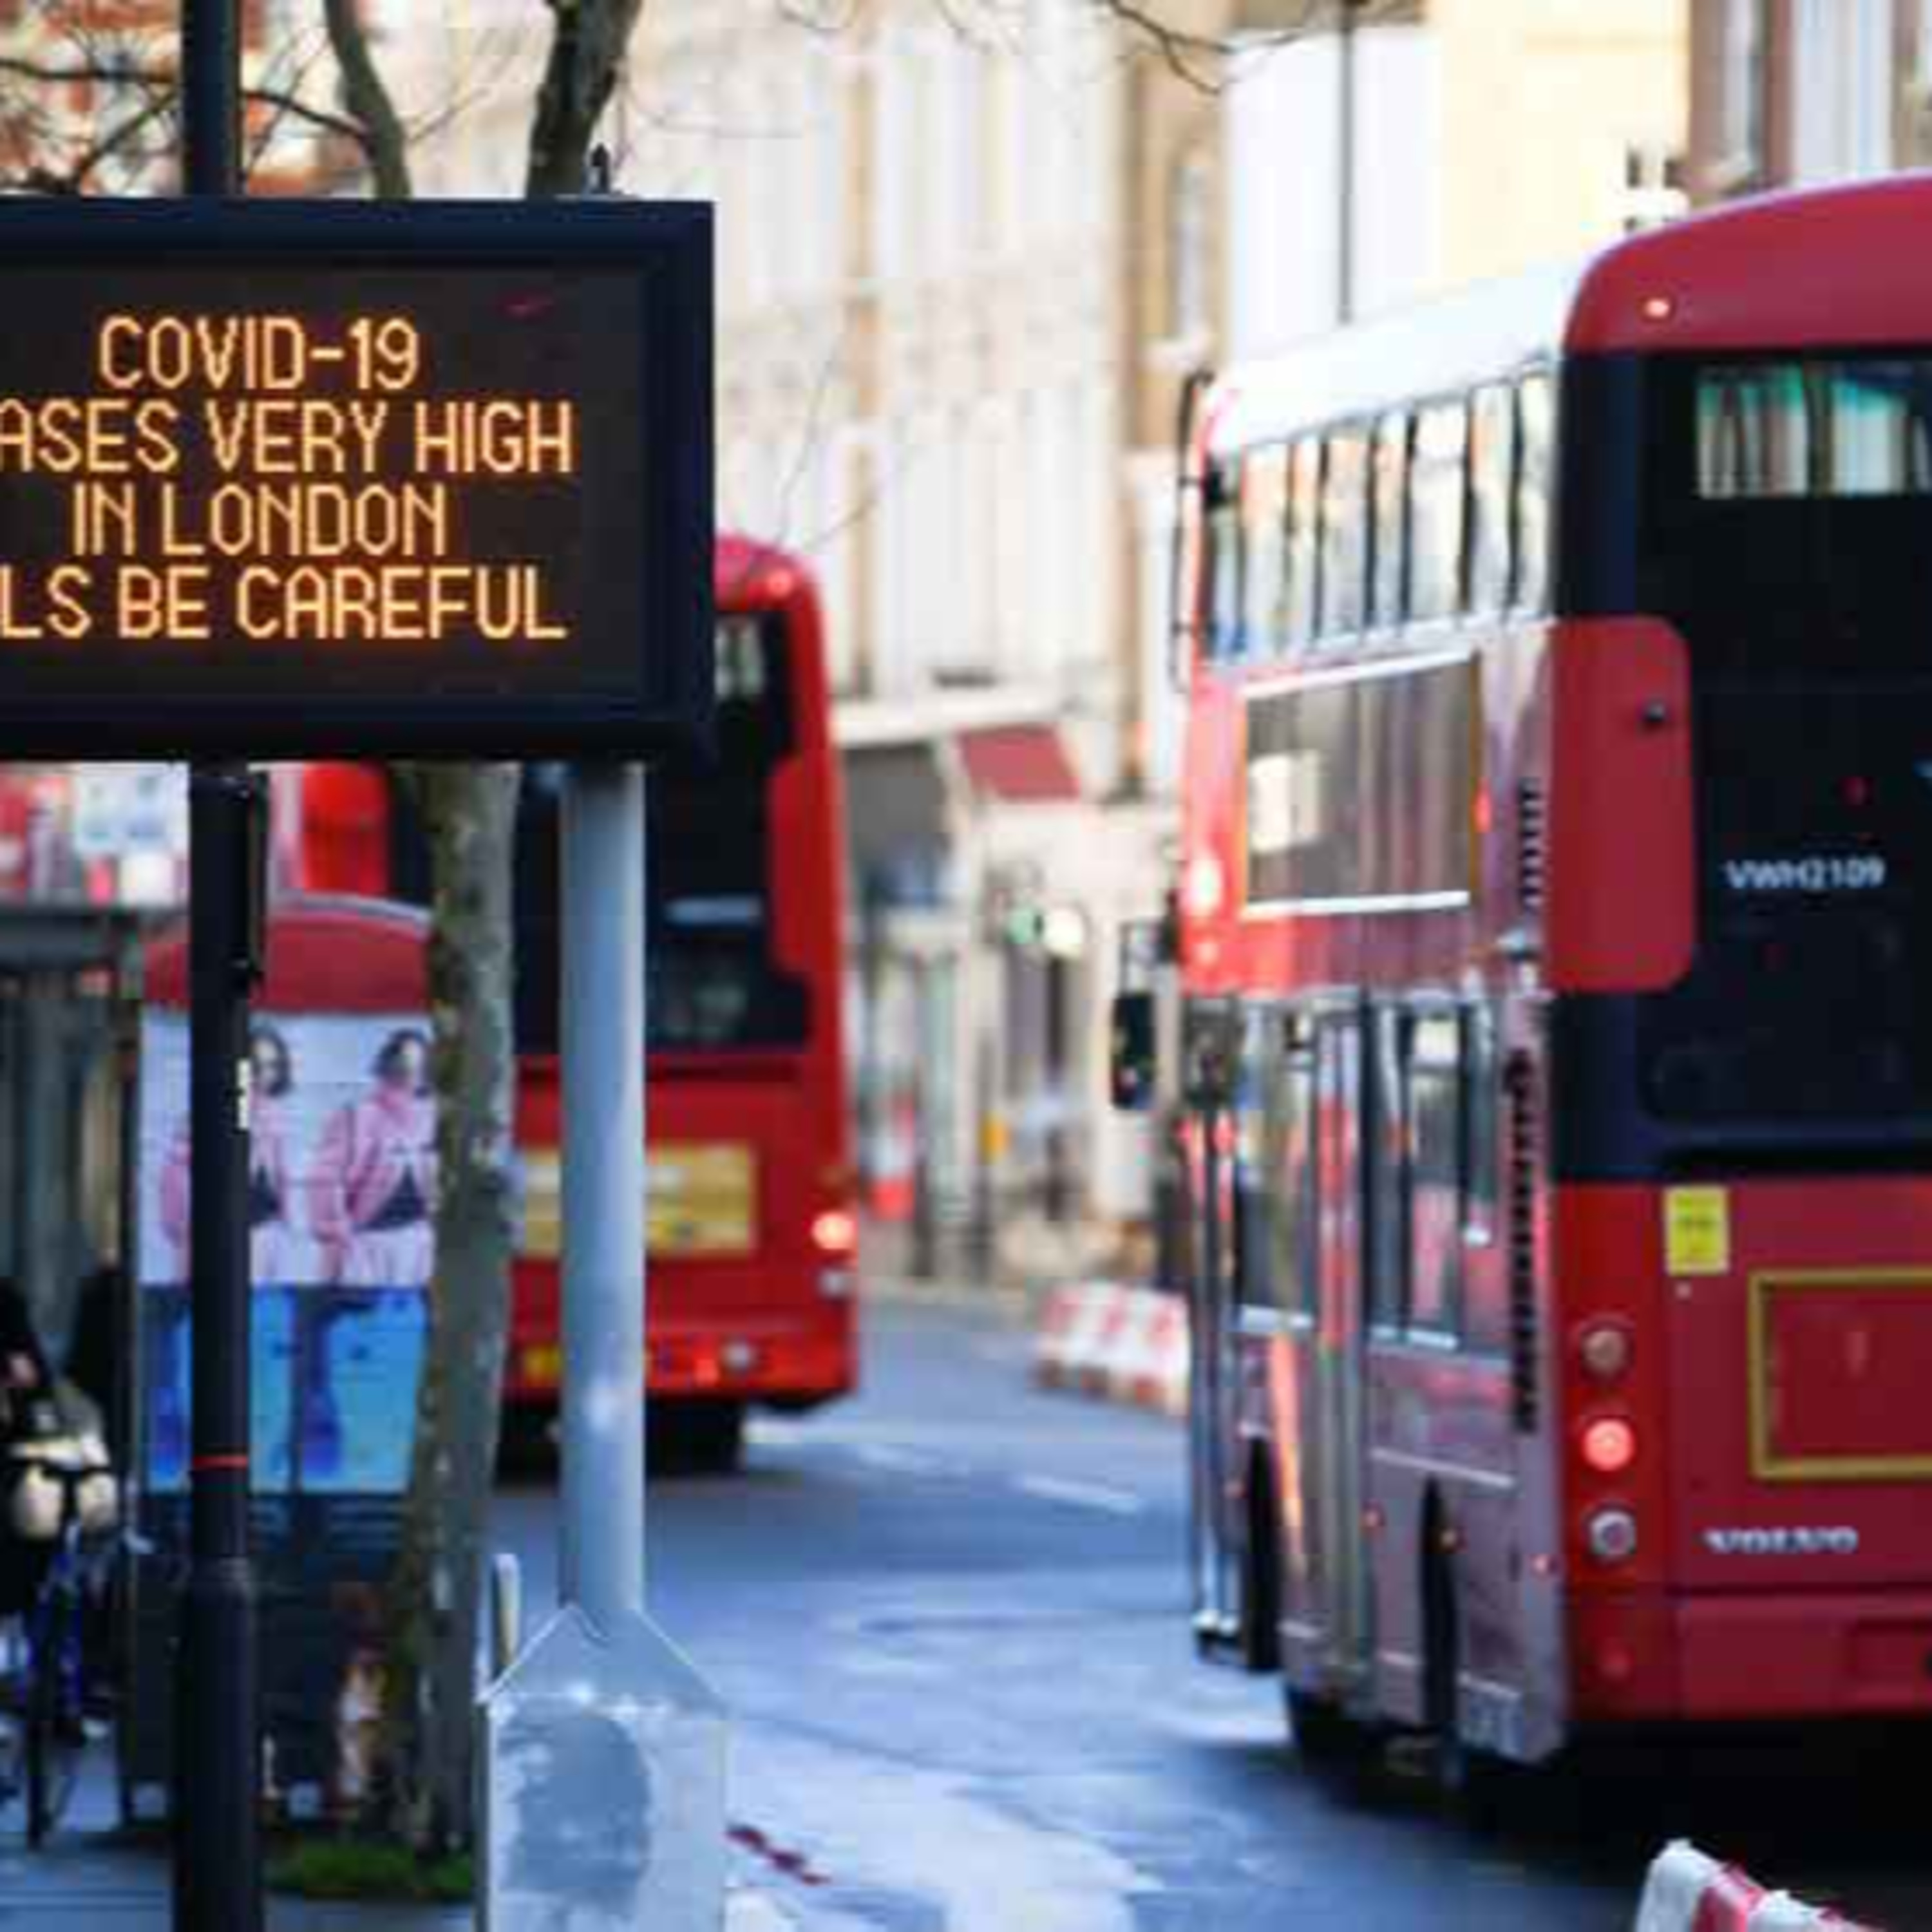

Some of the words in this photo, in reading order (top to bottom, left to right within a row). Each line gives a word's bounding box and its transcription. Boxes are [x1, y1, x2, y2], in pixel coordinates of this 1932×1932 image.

[100, 316, 419, 390] COVID-19
[205, 400, 388, 473] VERY
[415, 401, 573, 473] HIGH
[73, 483, 135, 556] IN
[162, 483, 446, 556] LONDON
[118, 565, 209, 638] BE
[236, 565, 567, 639] CAREFUL
